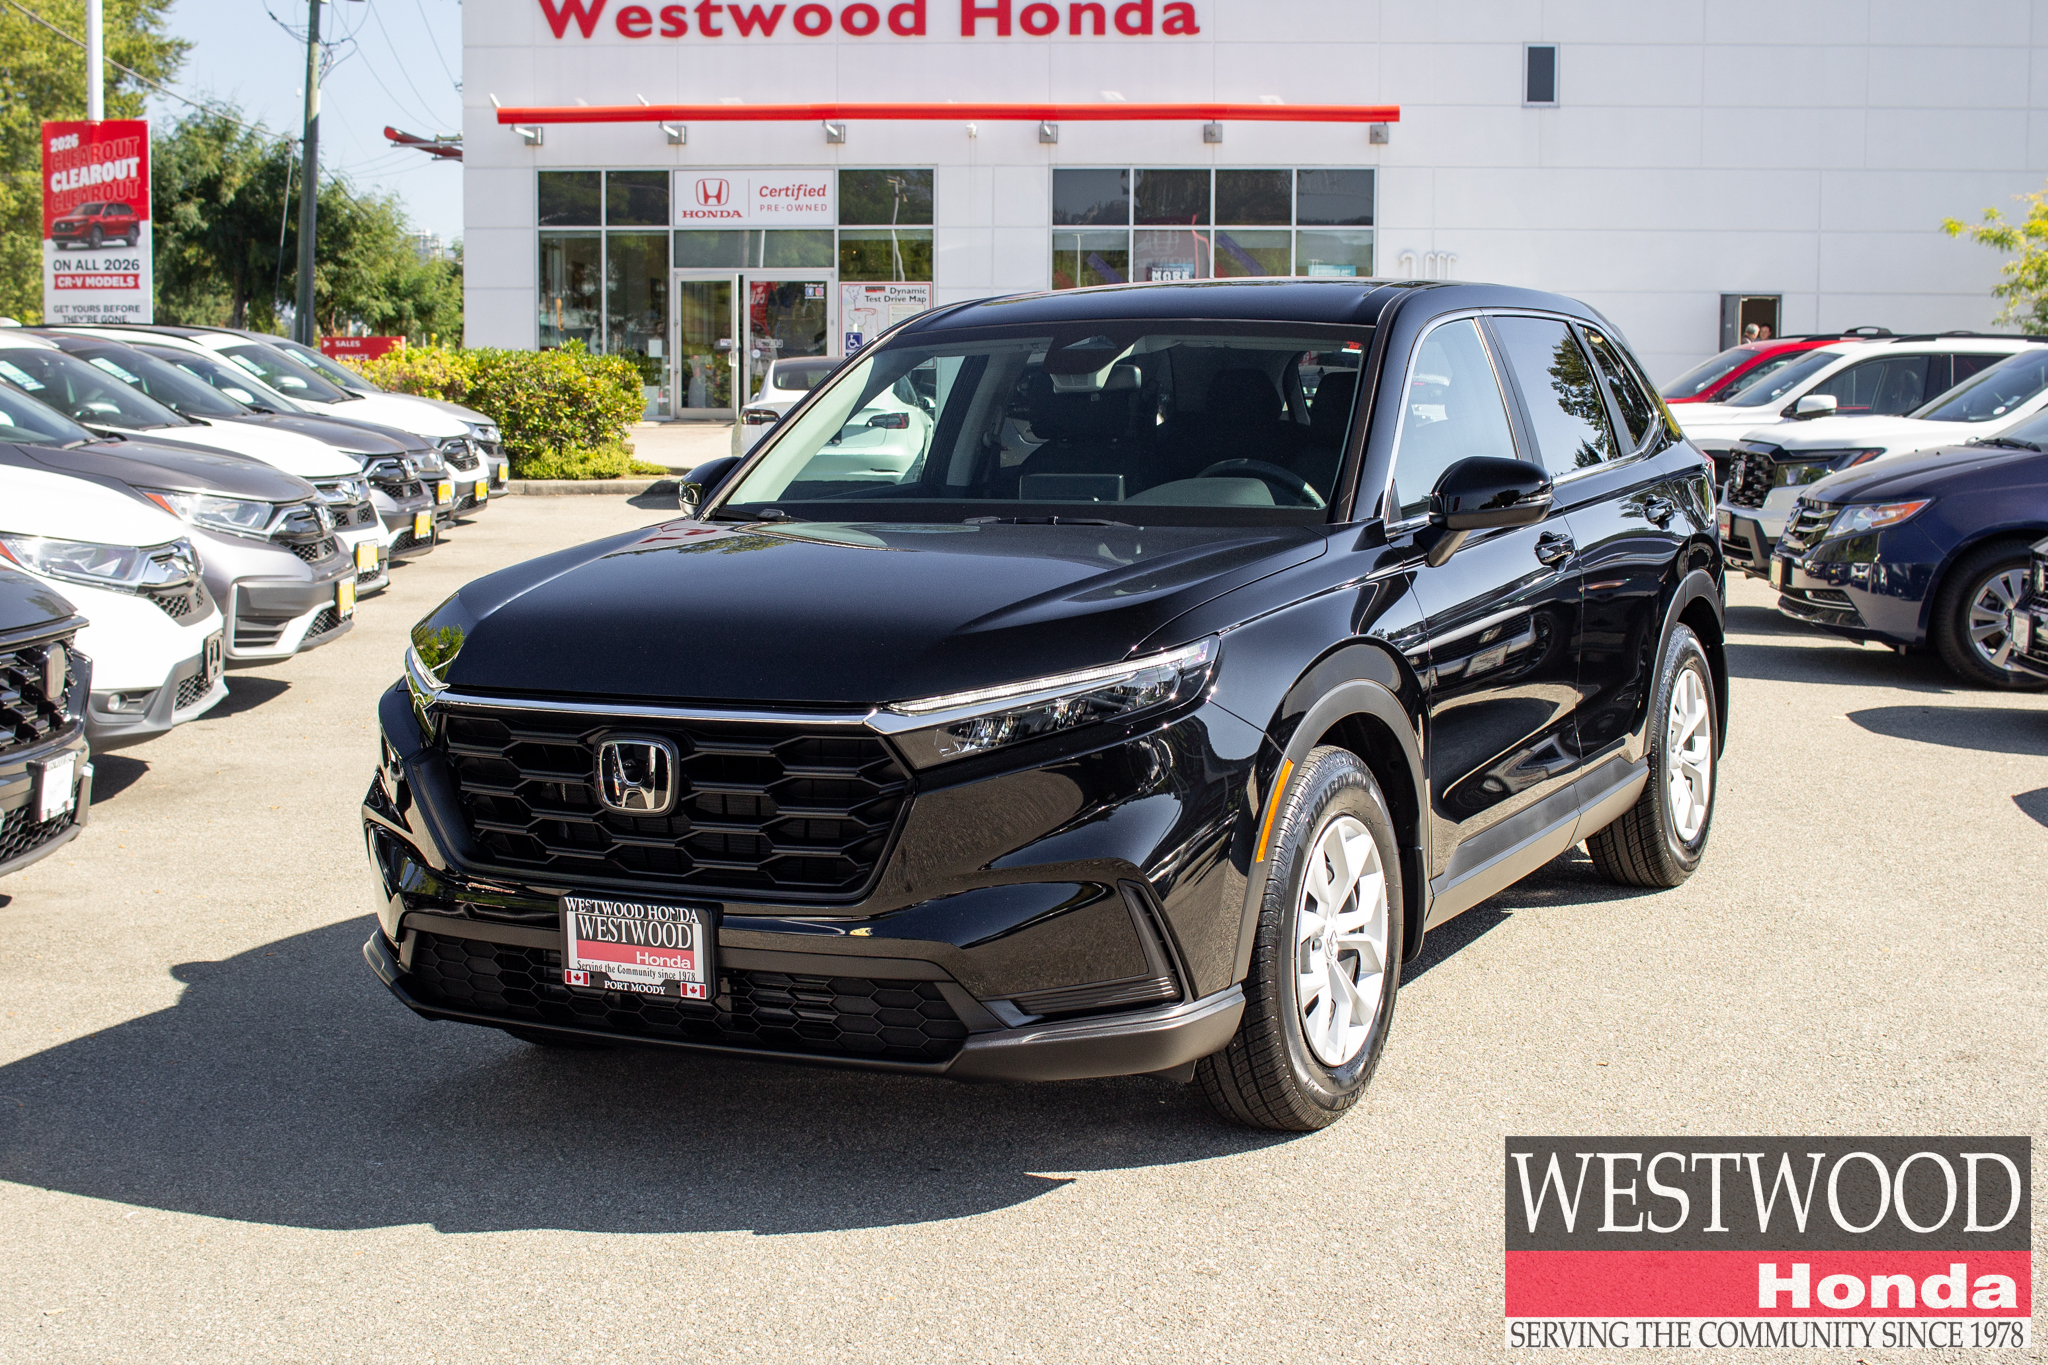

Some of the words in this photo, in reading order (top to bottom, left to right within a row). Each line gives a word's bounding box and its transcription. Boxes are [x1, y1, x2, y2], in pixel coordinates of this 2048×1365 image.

[538, 0, 927, 39] Westwood
[961, 0, 1201, 37] Honda
[51, 133, 79, 153] 2026
[51, 136, 140, 173] CLEAROUT
[51, 157, 140, 193] CLEAROUT
[759, 184, 827, 201] Certified
[682, 210, 743, 218] HONDA
[760, 204, 828, 212] PRE-OWNED
[53, 259, 71, 271] ON
[75, 259, 100, 271] ALL
[104, 259, 140, 271] 2026
[57, 276, 84, 288] CR-V
[85, 276, 136, 288] MODELS
[1152, 271, 1190, 281] MORE
[890, 287, 927, 296] Dynamic
[864, 295, 882, 303] Test
[884, 295, 907, 303] Drive
[909, 295, 927, 304] Map
[53, 305, 70, 313] GET
[72, 305, 101, 313] YOURS
[103, 305, 141, 313] BEFORE
[62, 315, 98, 324] THEY'RE
[335, 340, 361, 348] SALES
[564, 897, 645, 919] WESTWOOD
[647, 905, 700, 924] HONDA
[577, 914, 692, 949] WESTWOOD
[636, 951, 691, 969] Honda
[576, 960, 603, 973] Serving
[604, 963, 616, 973] the
[617, 965, 656, 981] Community
[657, 969, 676, 980] since
[678, 970, 696, 982] 1978
[604, 980, 629, 991] PORT
[631, 982, 666, 995] MOODY
